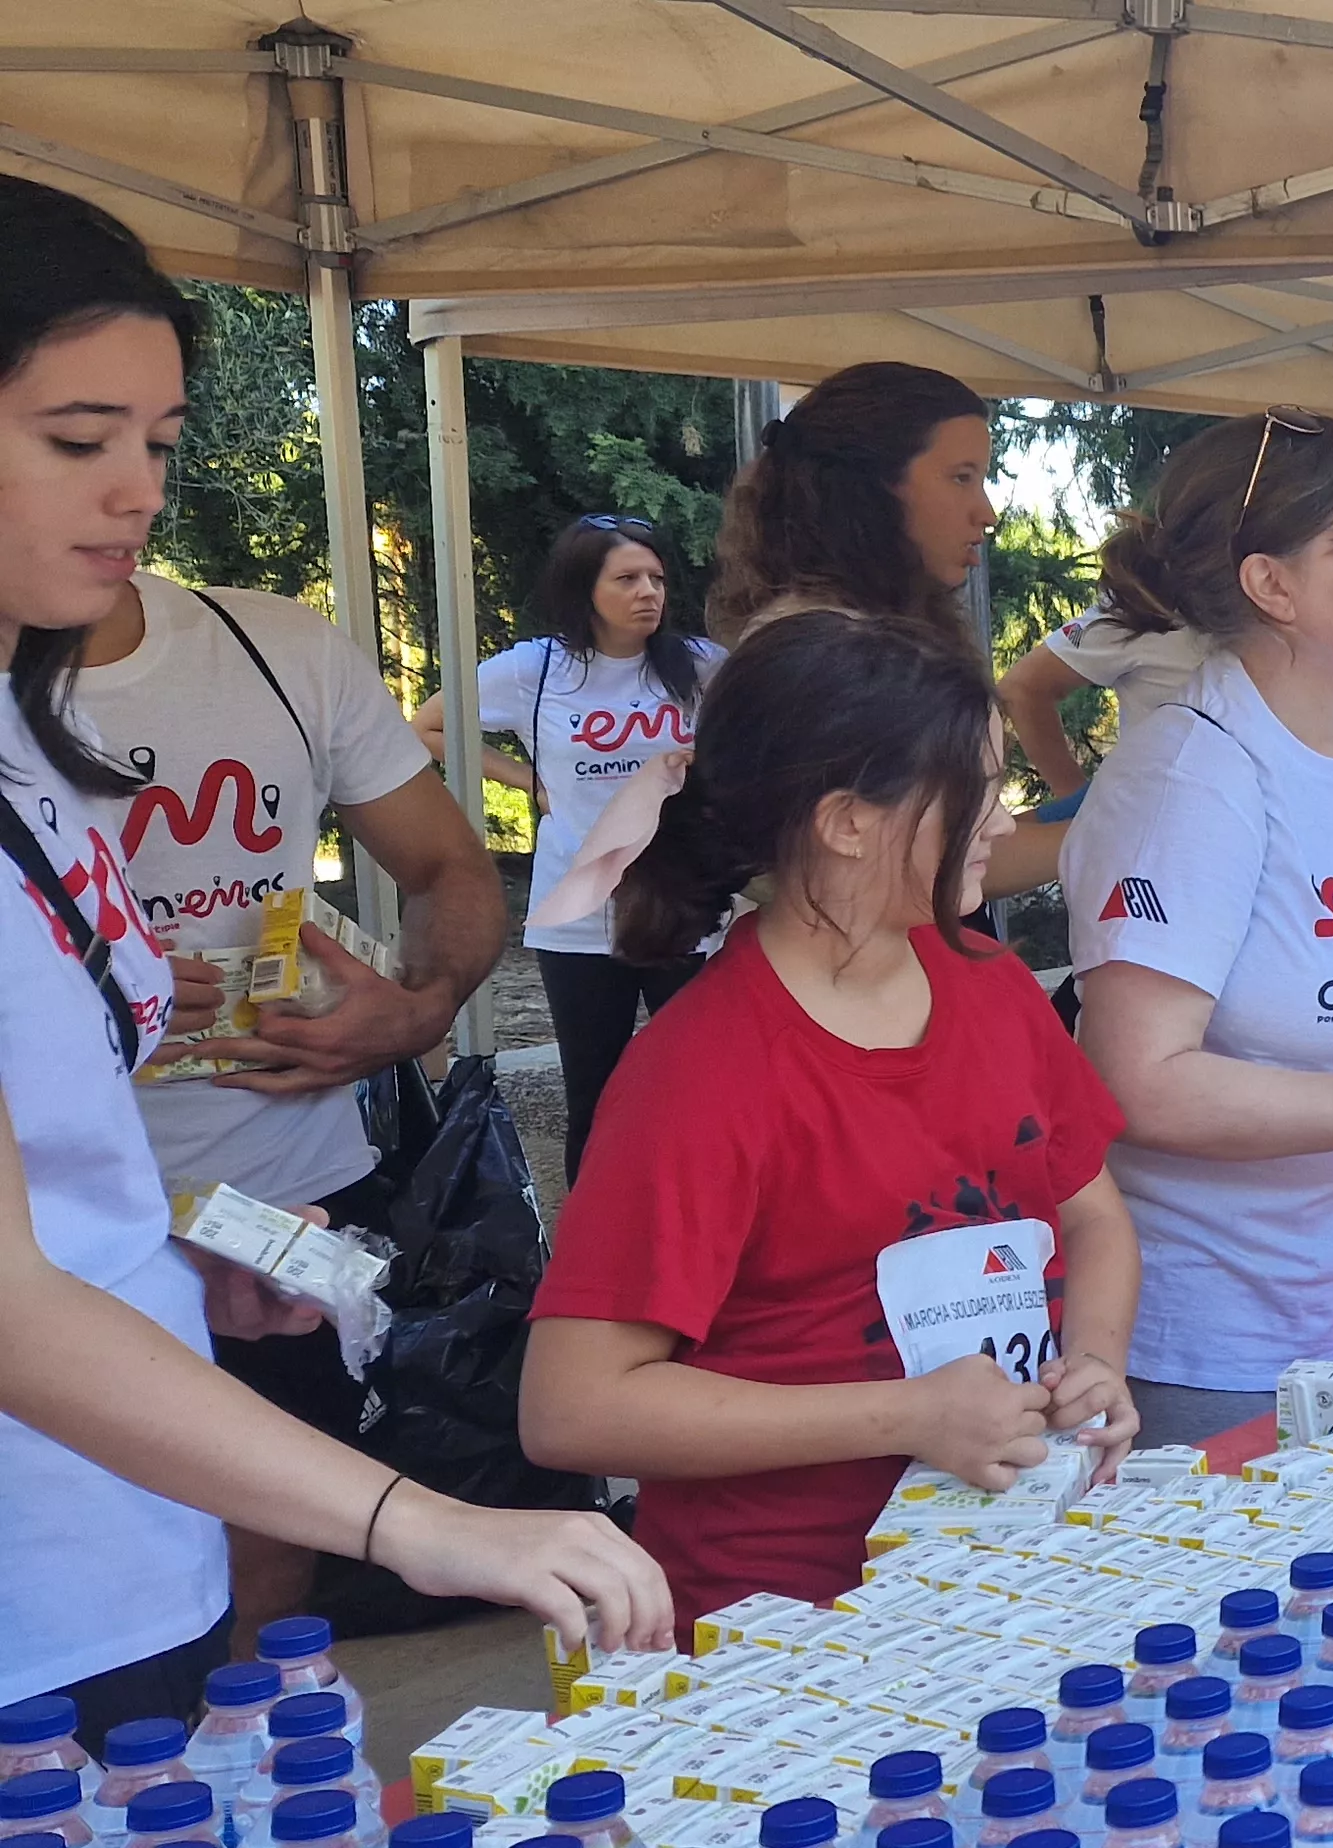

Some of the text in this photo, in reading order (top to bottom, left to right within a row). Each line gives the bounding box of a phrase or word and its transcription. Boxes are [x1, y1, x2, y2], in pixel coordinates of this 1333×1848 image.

[575, 758, 641, 776] Camin
[903, 1303, 952, 1332] MARCHA
[950, 1296, 998, 1321] SOLIDARIA
[998, 1292, 1012, 1313] POR
[1012, 1291, 1023, 1312] LA
